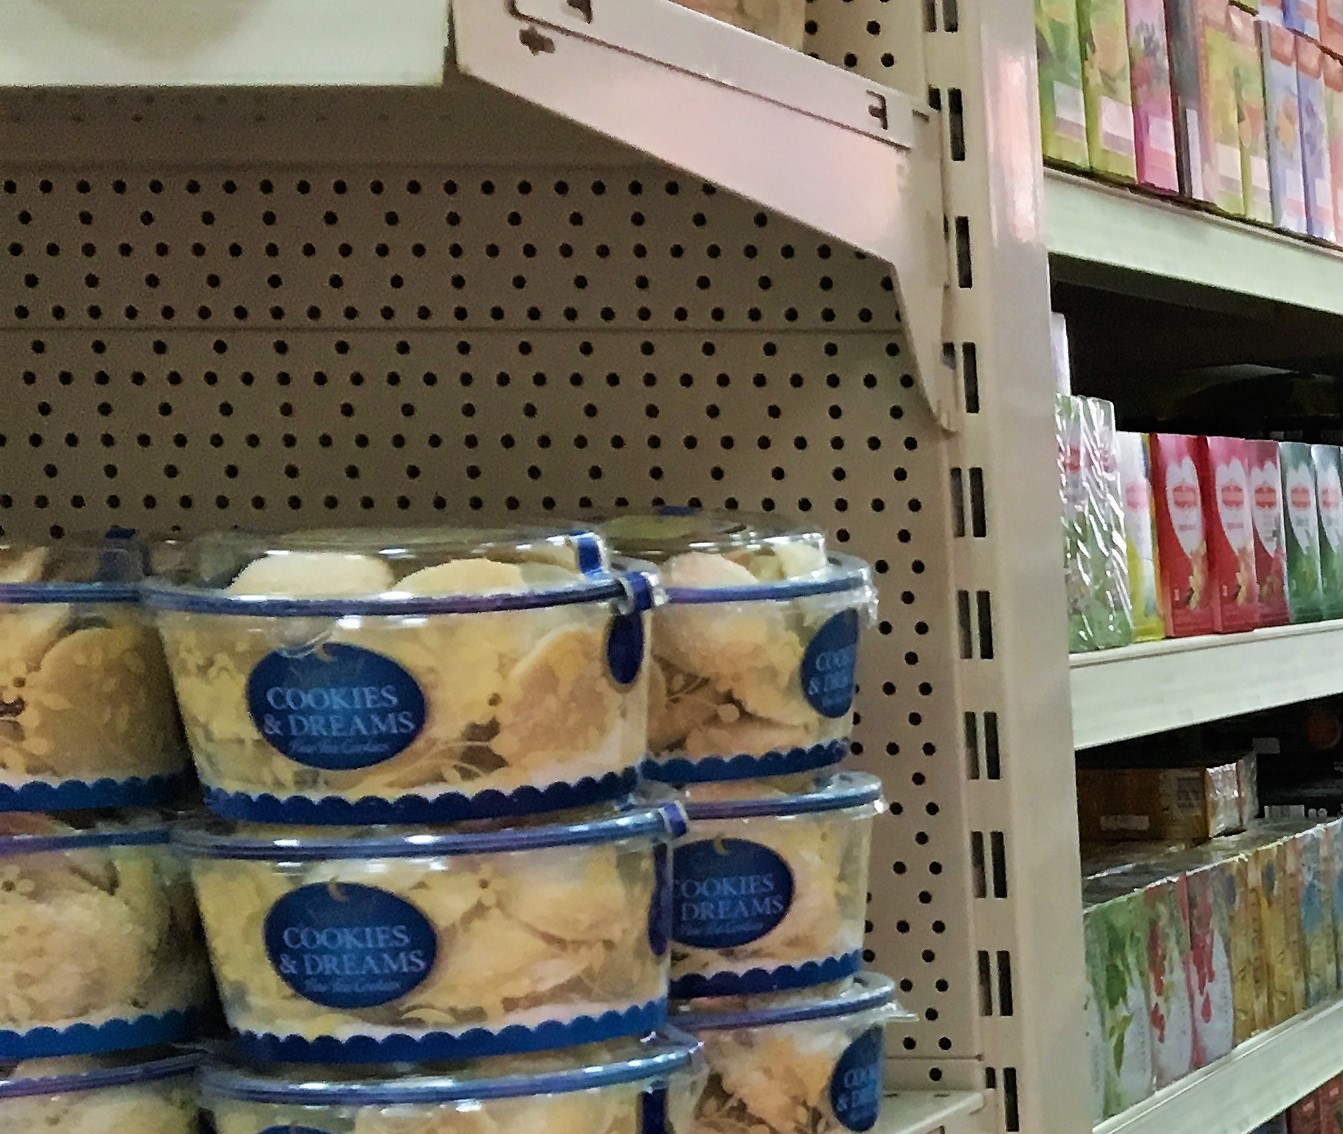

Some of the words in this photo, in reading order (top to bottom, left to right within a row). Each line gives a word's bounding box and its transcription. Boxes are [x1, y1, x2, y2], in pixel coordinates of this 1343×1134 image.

[266, 685, 398, 710] COOKIES
[262, 713, 284, 736] &
[287, 710, 415, 737] DREAMS
[674, 873, 774, 899] OOKIES
[681, 895, 784, 920] DREAMS
[283, 925, 411, 949] COOKIES
[279, 953, 298, 974] &
[303, 949, 428, 975] DREAMS
